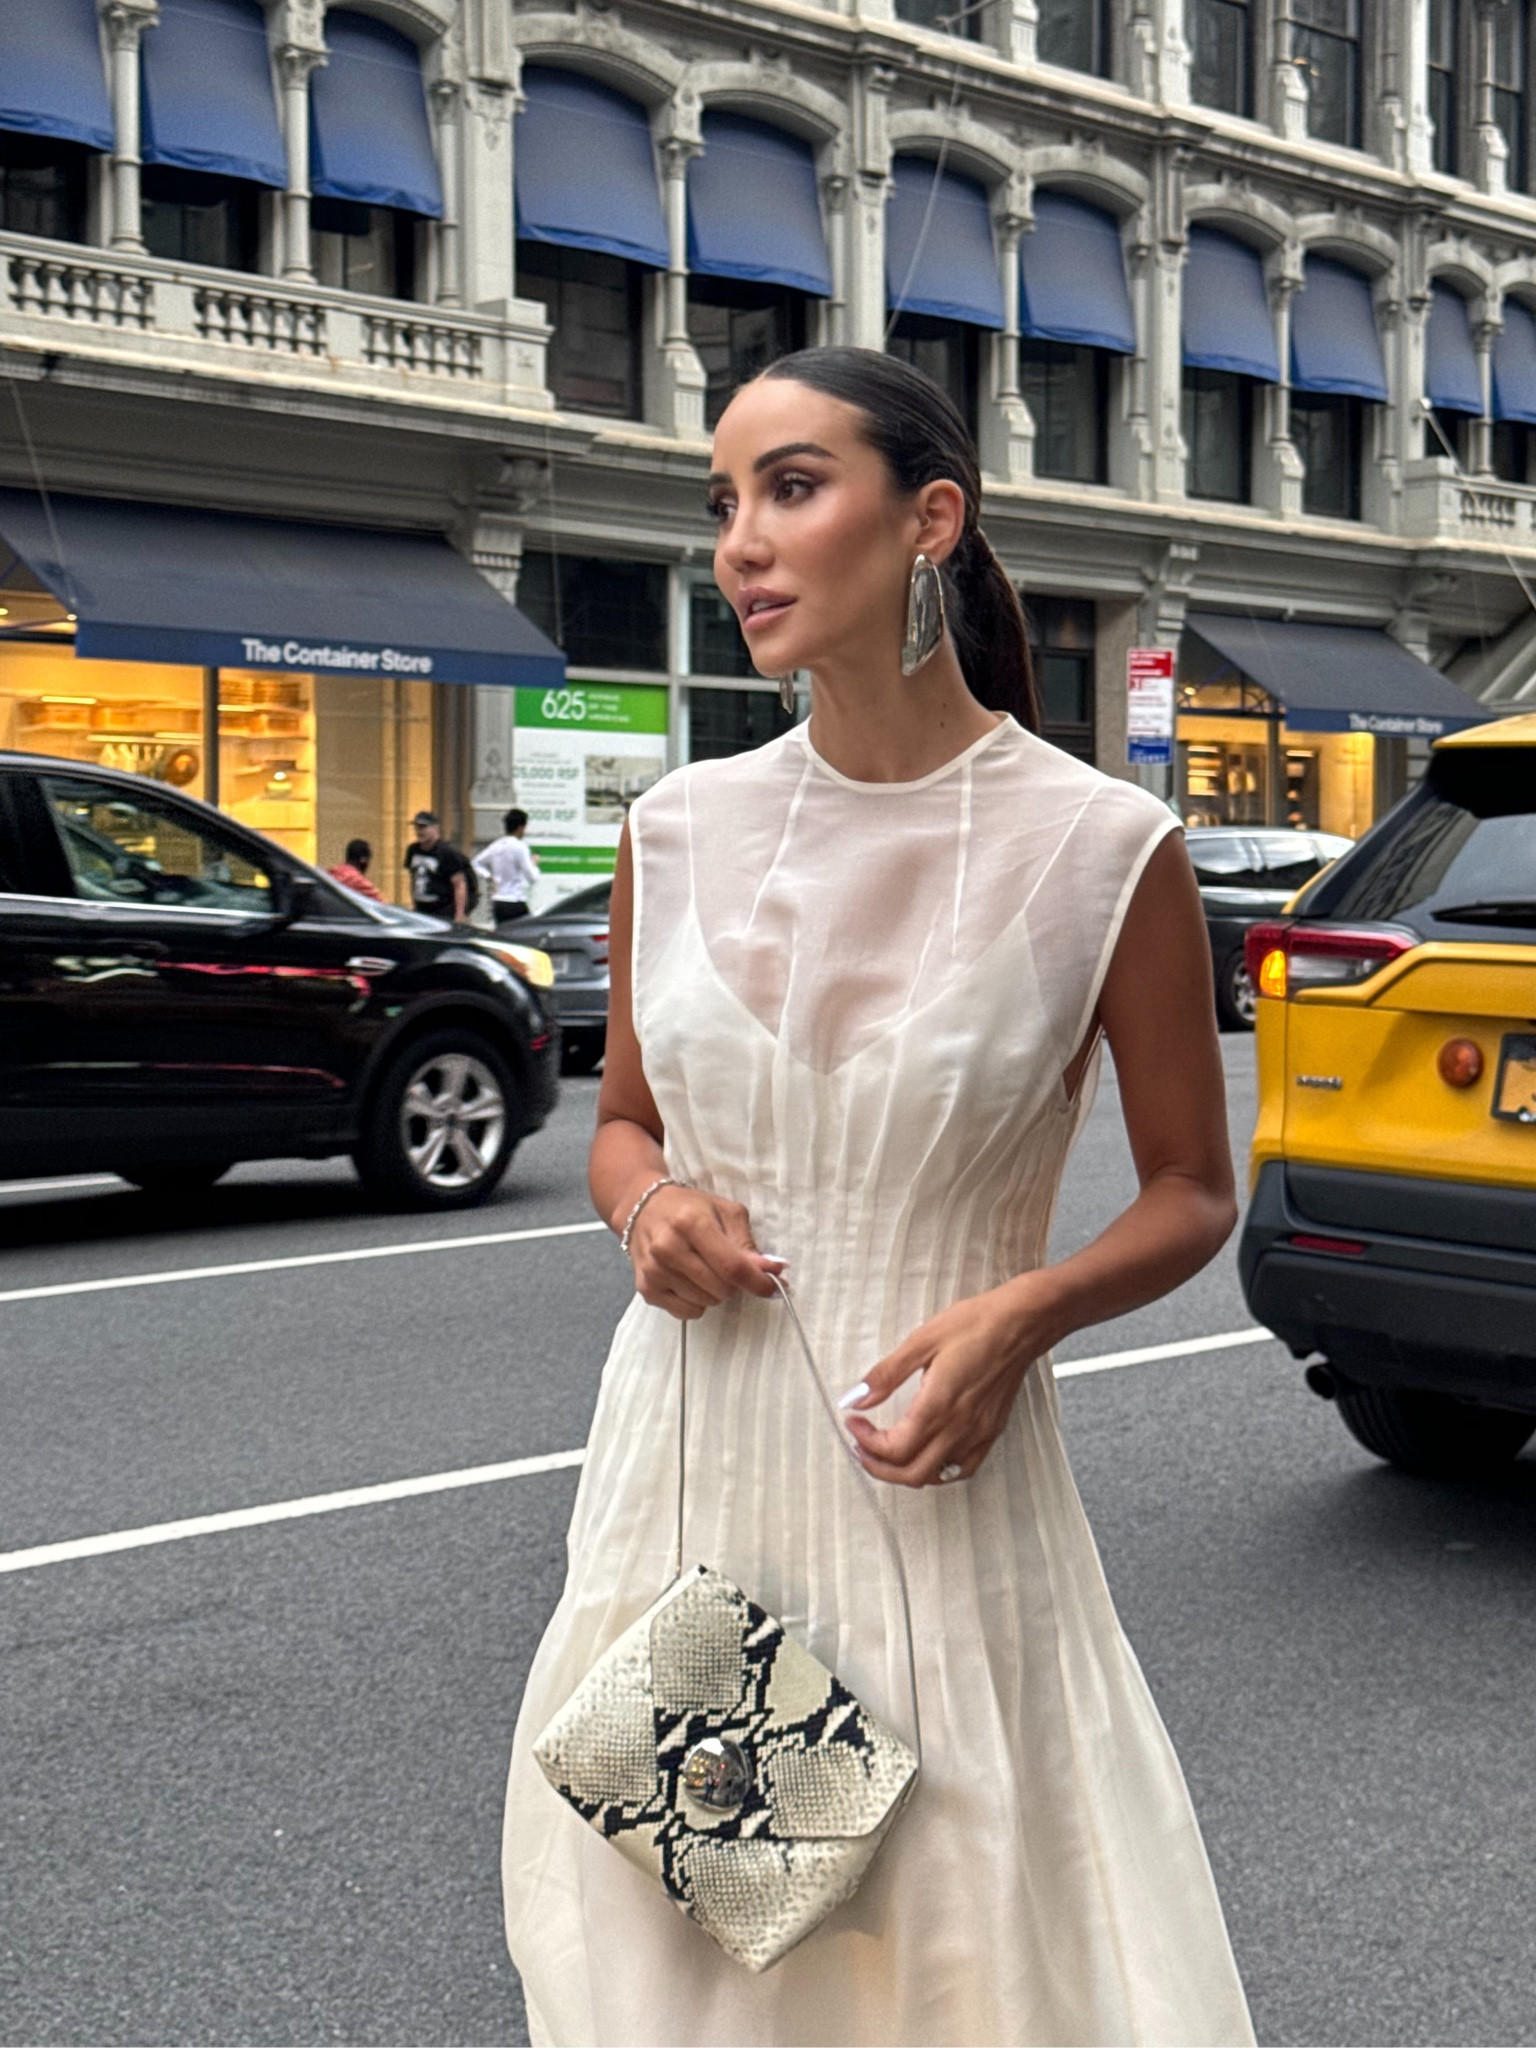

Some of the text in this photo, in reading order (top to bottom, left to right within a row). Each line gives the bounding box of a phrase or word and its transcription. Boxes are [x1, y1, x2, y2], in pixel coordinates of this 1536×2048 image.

[241, 638, 433, 674] The Container Store
[541, 689, 587, 720] 625
